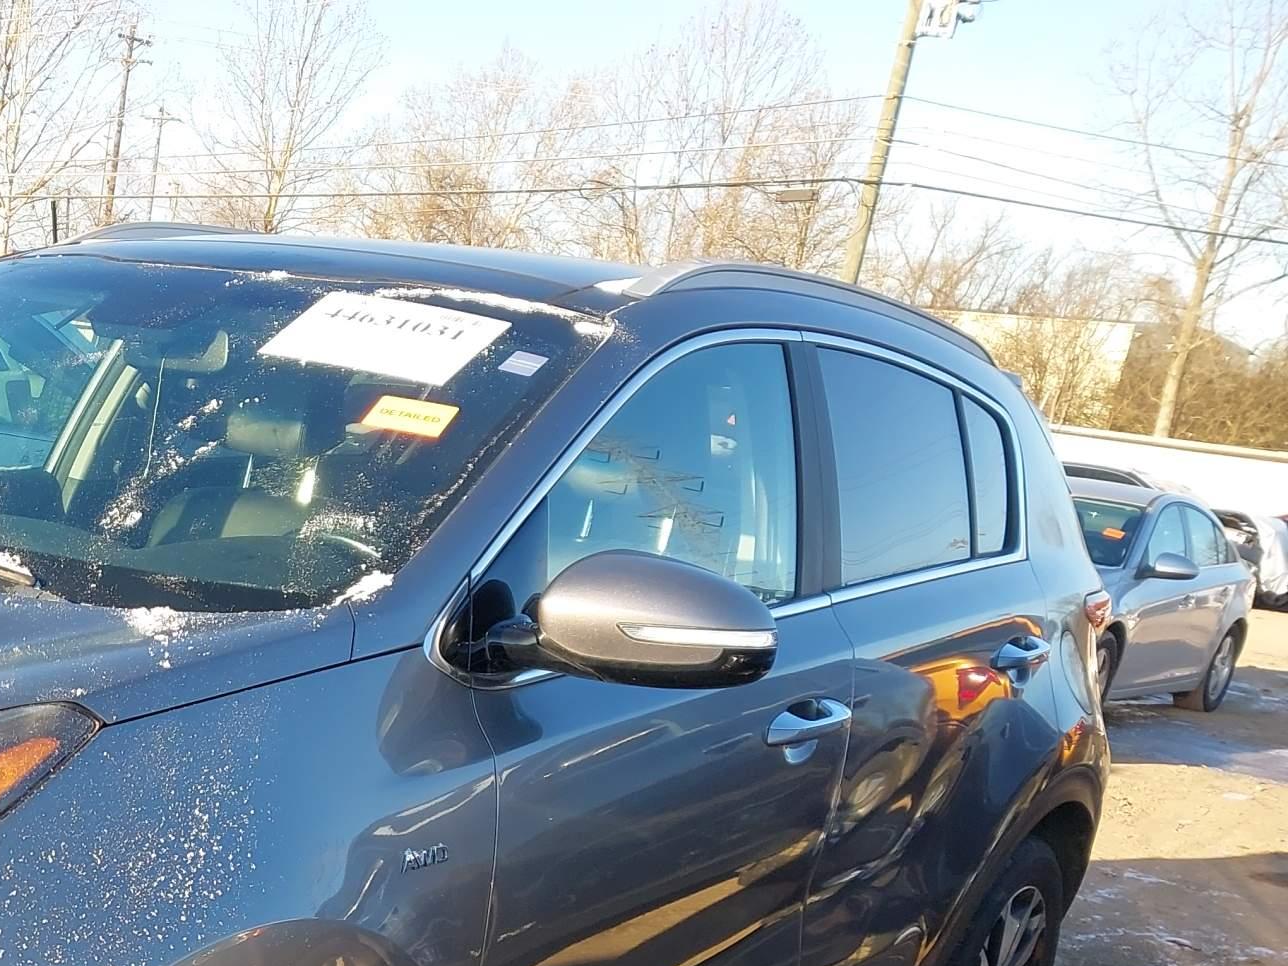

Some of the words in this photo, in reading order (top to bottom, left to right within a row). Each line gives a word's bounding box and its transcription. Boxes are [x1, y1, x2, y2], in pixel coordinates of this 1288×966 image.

[325, 308, 465, 340] 44631031
[379, 408, 441, 423] DETAILED
[400, 842, 449, 874] AWD
